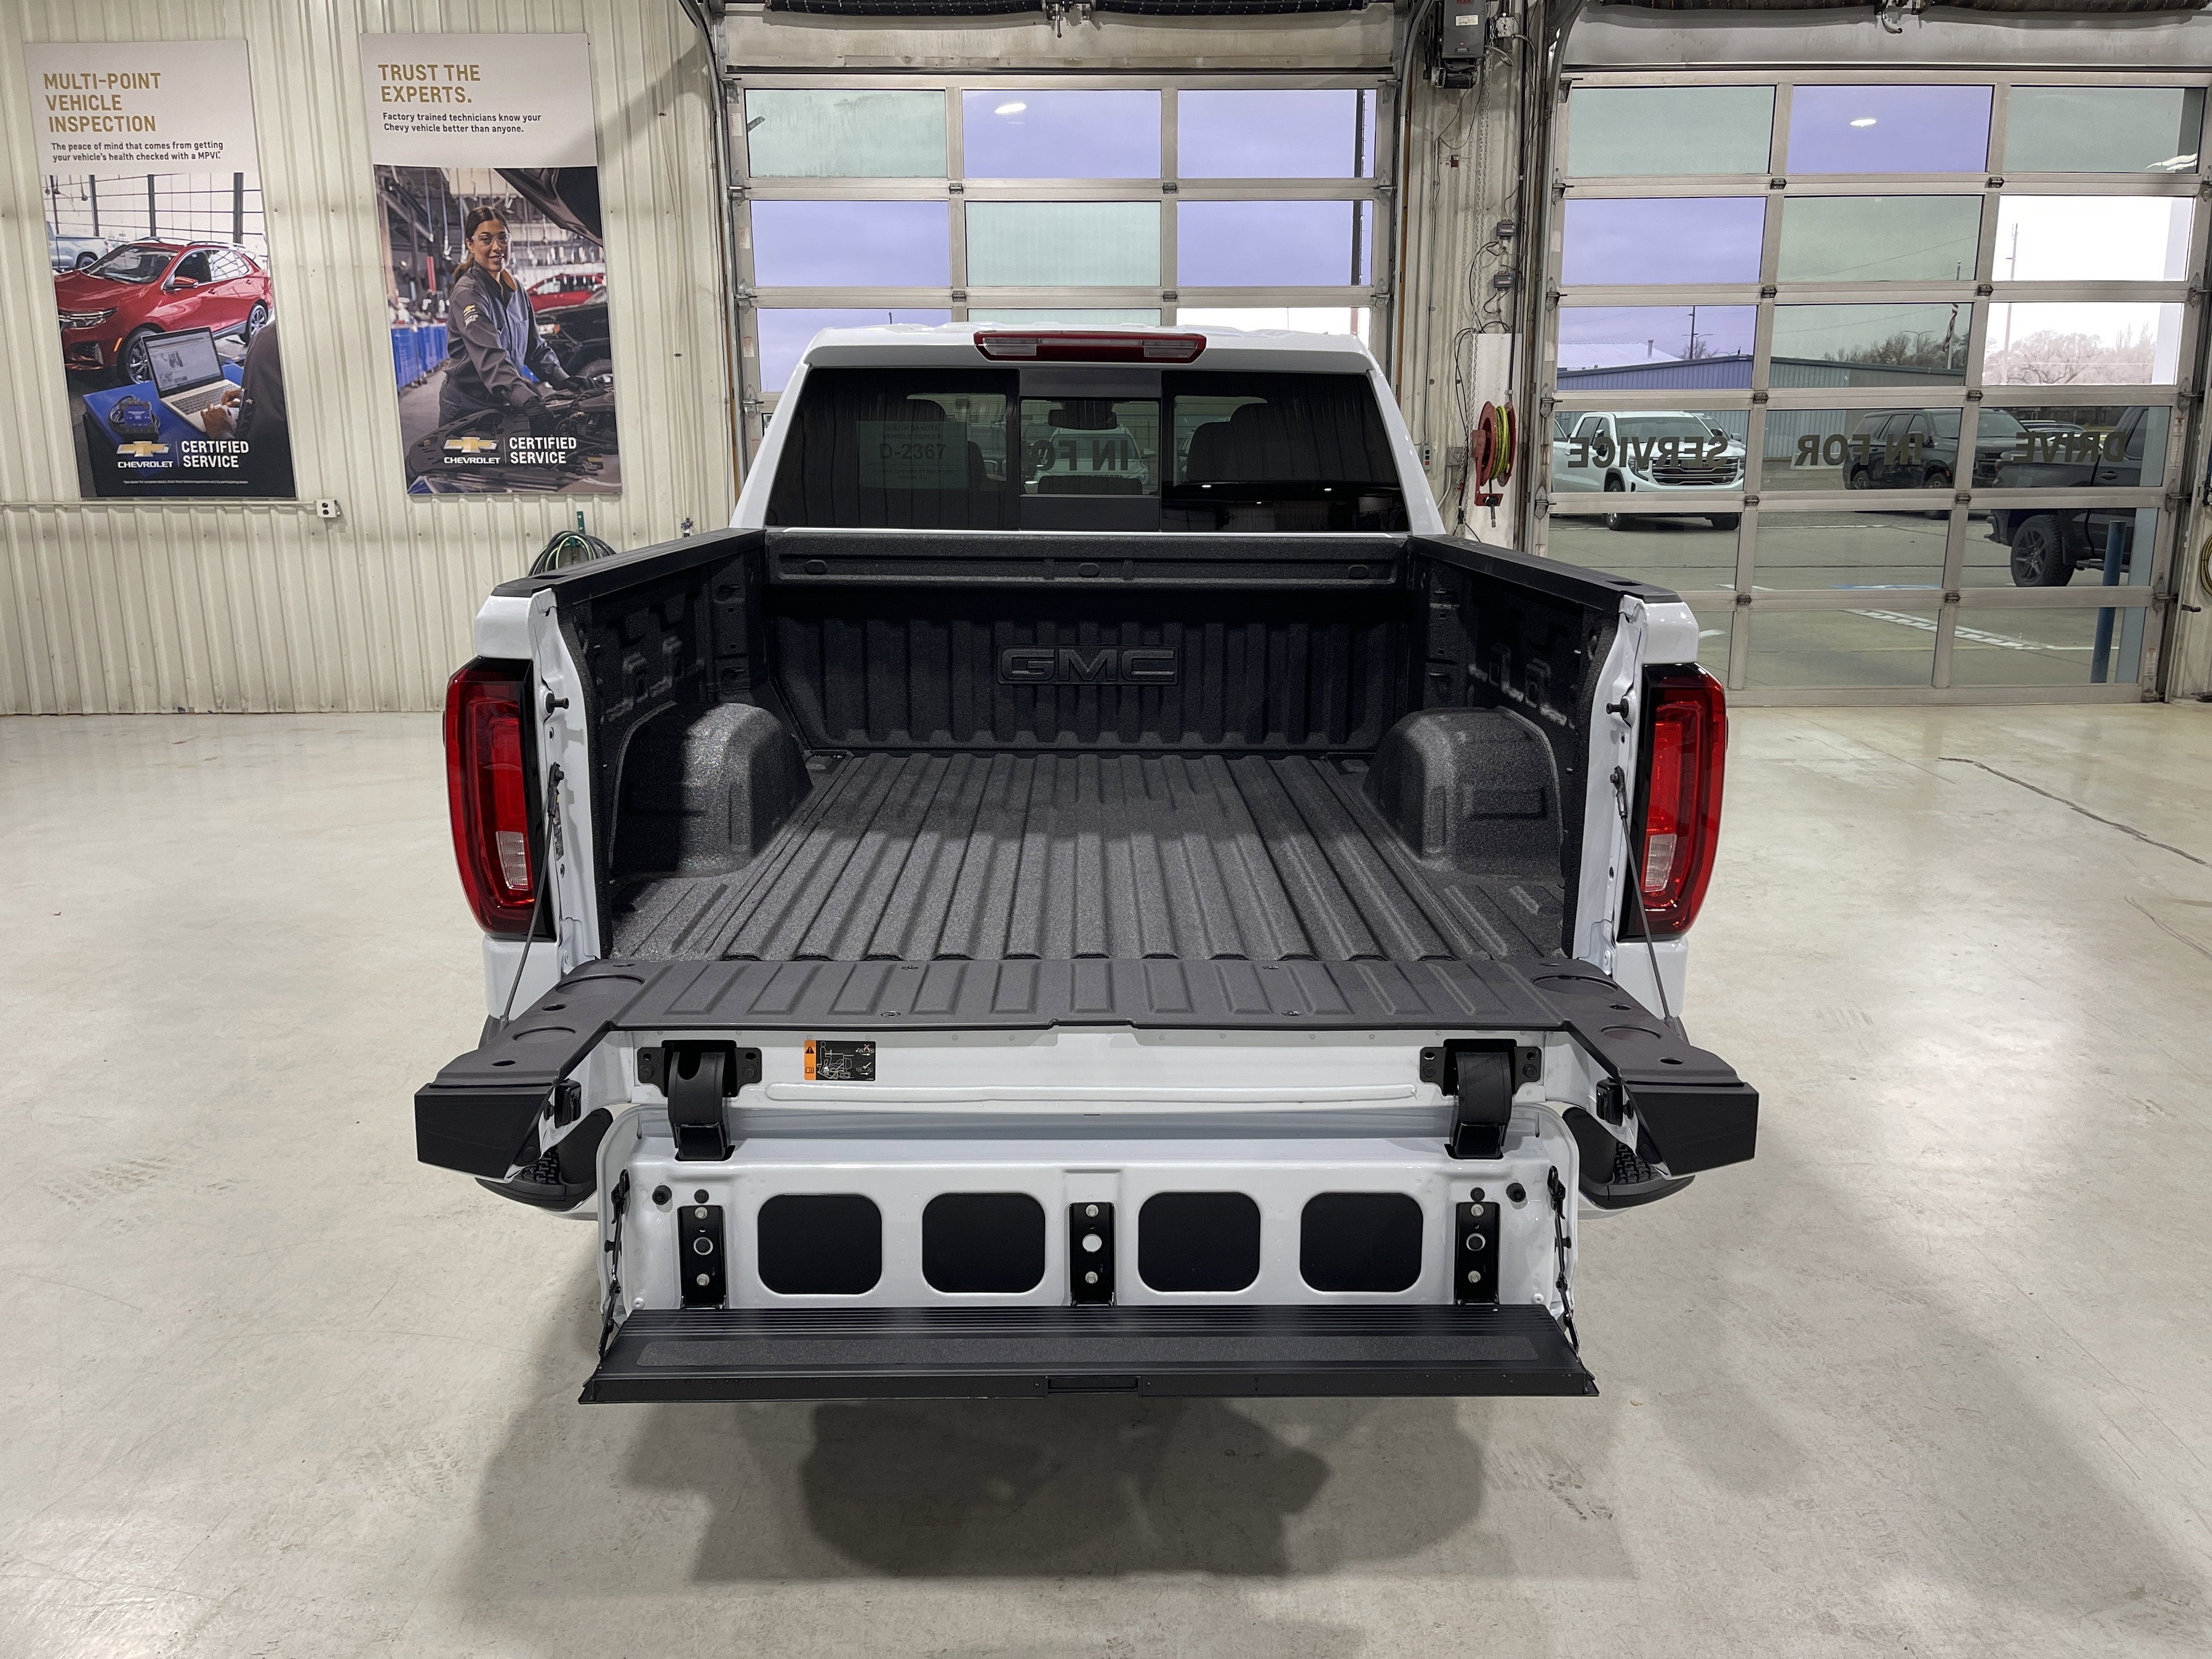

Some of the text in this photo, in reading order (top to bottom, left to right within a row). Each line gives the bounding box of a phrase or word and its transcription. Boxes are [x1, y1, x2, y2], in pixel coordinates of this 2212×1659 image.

[378, 64, 481, 81] TRUST THE
[43, 72, 161, 89] MULTI-POINT
[381, 86, 472, 103] EXPERTS.
[46, 94, 123, 111] VEHICLE
[49, 115, 156, 133] INSPECTION
[383, 112, 541, 123] Factory trained technicians know your
[384, 123, 409, 133] Chevy
[411, 123, 440, 132] vehicle
[442, 124, 469, 132] better
[492, 126, 524, 134] anyone.
[69, 143, 92, 153] peace
[194, 141, 223, 151] getting
[53, 155, 71, 163] your
[73, 153, 106, 161] vehicle's
[109, 153, 134, 161] health
[171, 151, 189, 160] with
[181, 441, 249, 454] CERTIFIED
[509, 437, 577, 449] CERTIFIED
[510, 452, 566, 464] SERVICE
[879, 443, 946, 460] D-2367
[183, 455, 239, 468] SERVICE
[1001, 648, 1175, 681] GMC
